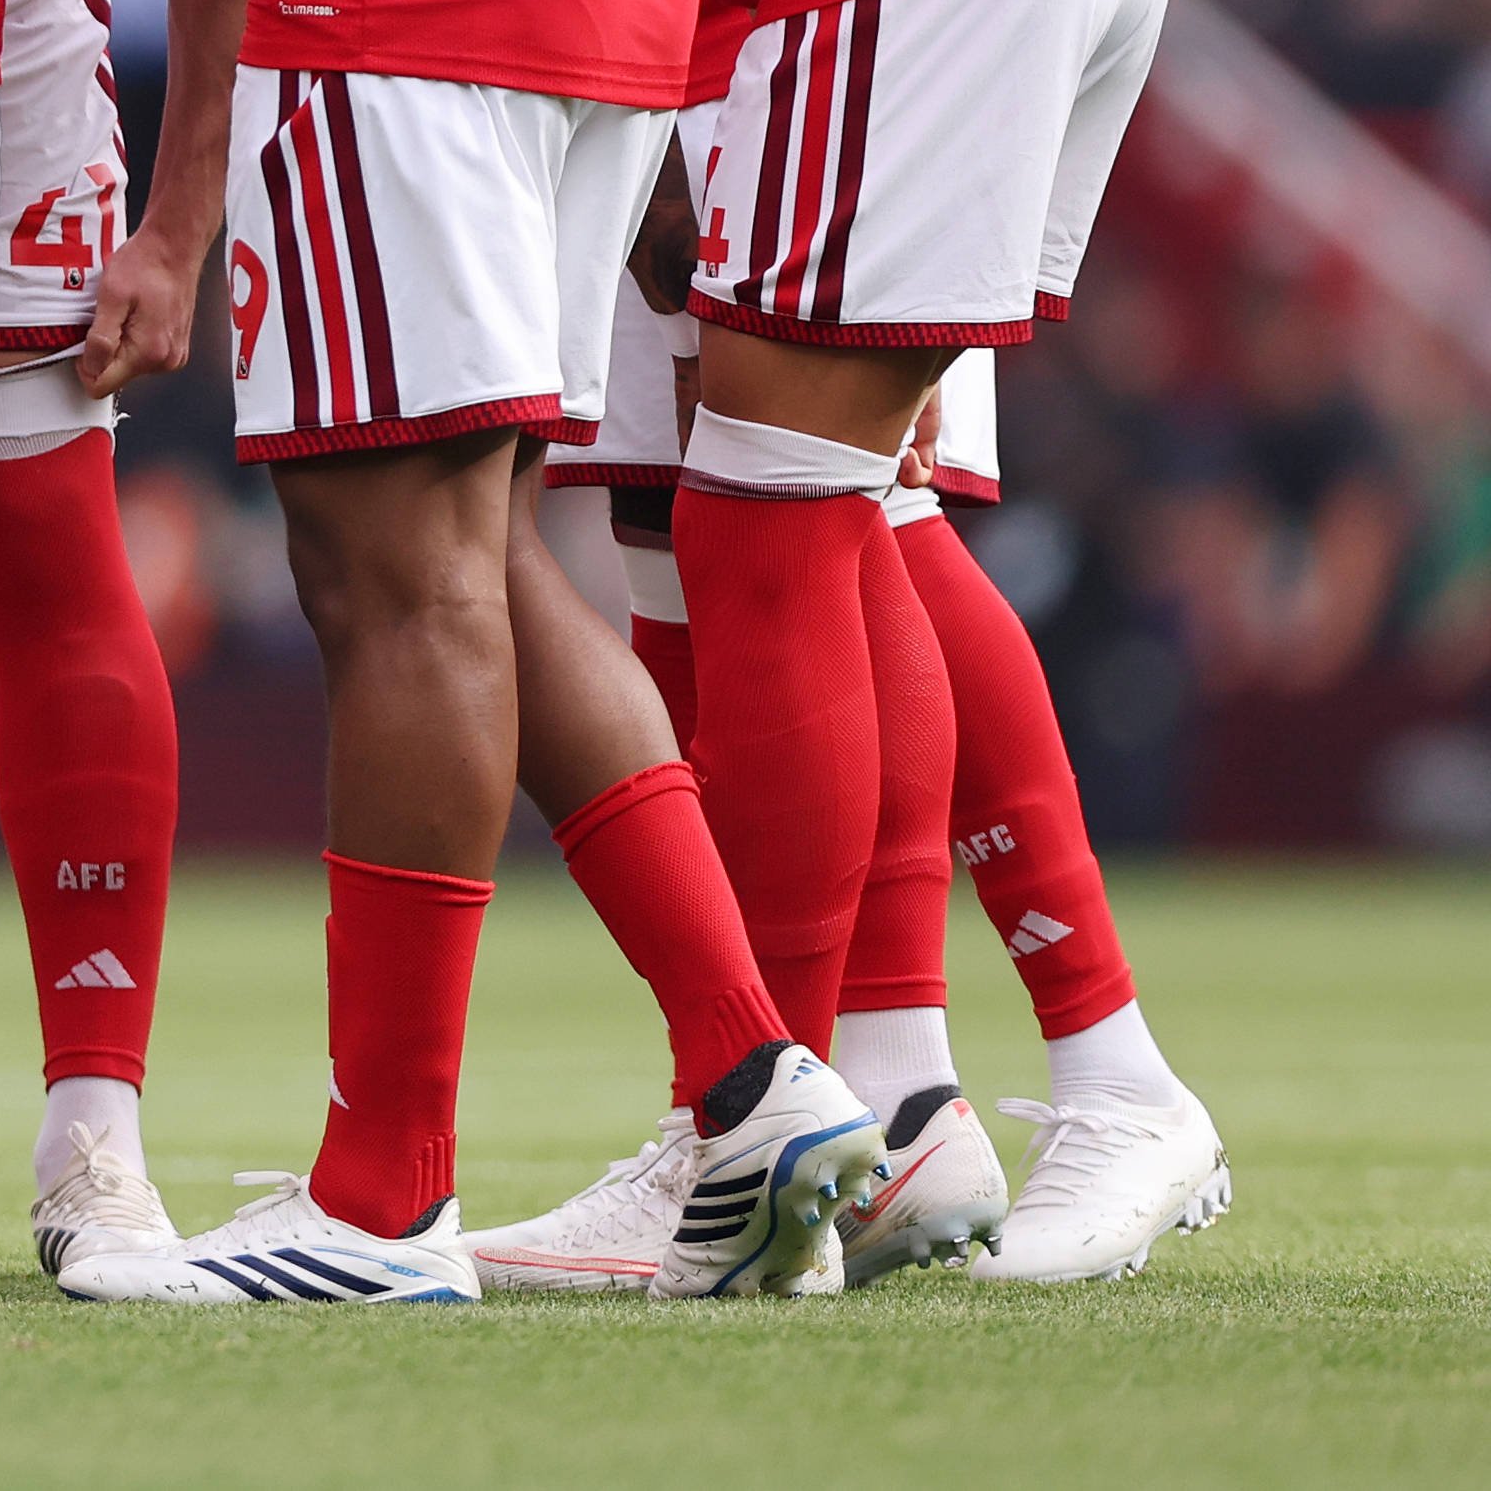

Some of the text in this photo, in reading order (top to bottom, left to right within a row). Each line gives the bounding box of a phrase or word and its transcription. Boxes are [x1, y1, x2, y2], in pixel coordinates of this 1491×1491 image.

[281, 4, 336, 16] CLIMACOOL
[956, 823, 1017, 867] AFC
[57, 859, 126, 890] AFC
